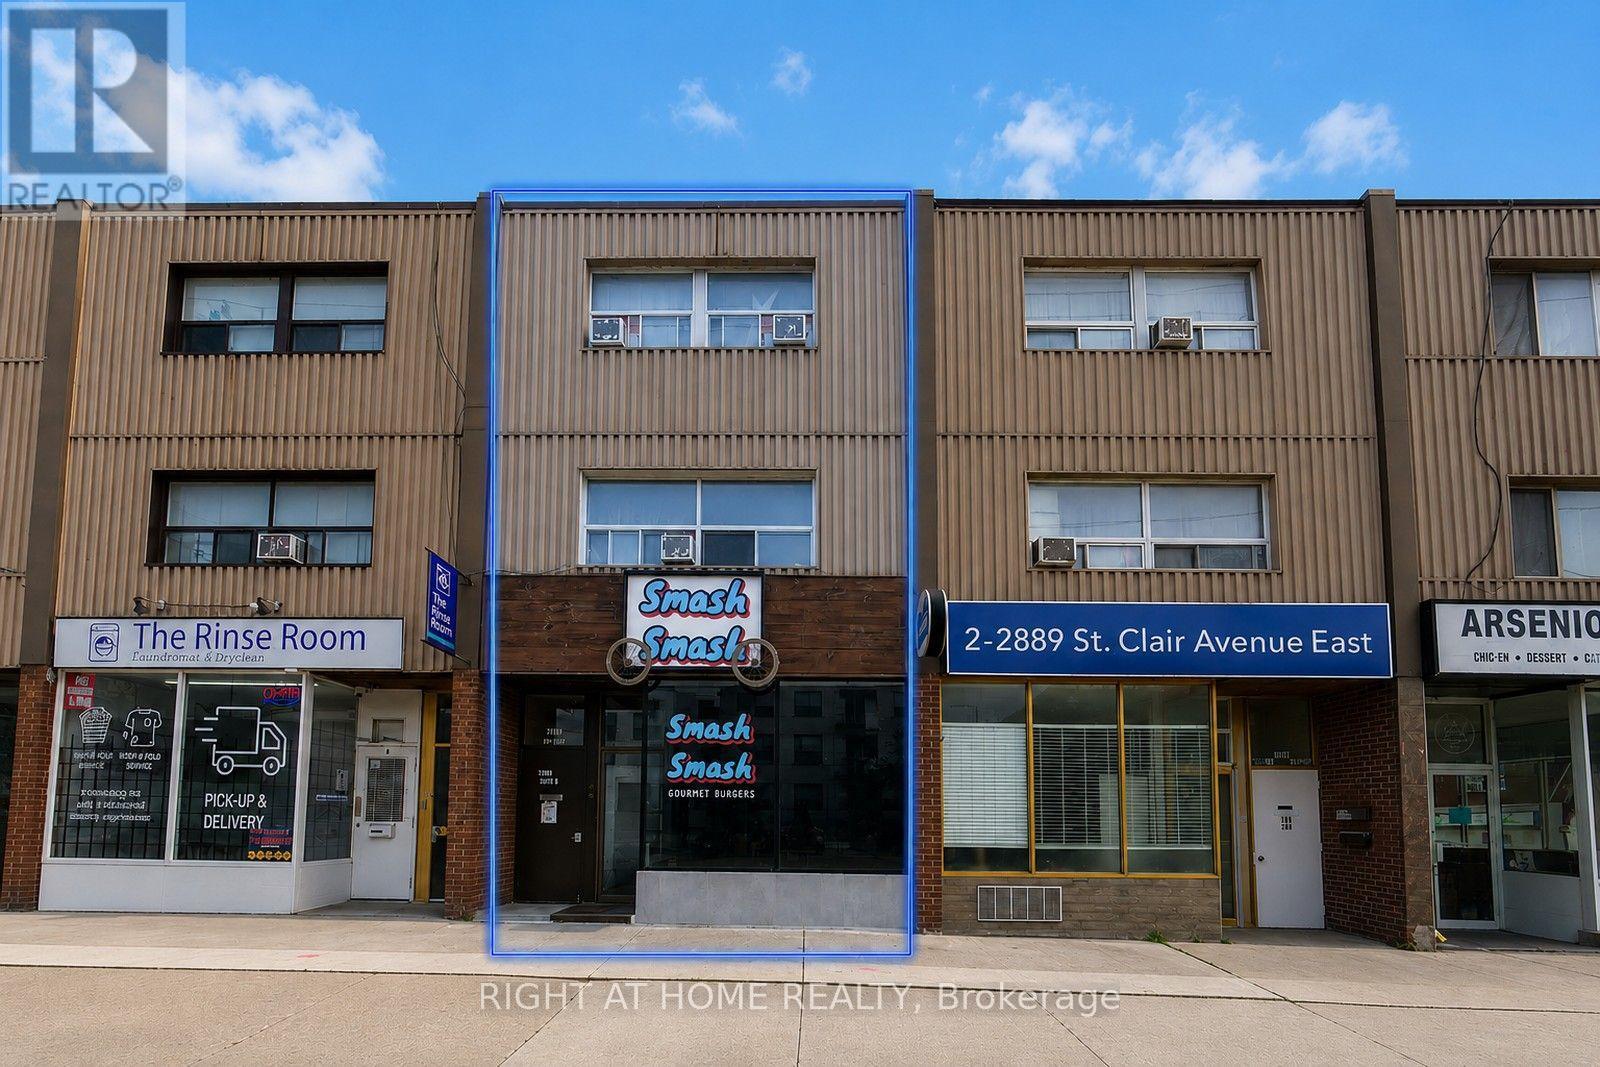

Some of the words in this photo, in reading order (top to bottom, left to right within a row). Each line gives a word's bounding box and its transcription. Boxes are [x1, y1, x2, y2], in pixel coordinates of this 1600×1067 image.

[431, 591, 447, 609] The
[639, 578, 750, 619] Smash
[133, 621, 186, 650] The
[195, 622, 272, 650] Rinse
[282, 623, 366, 651] Room
[430, 617, 453, 638] Room
[638, 625, 750, 666] Smash
[964, 627, 1064, 652] 2-2889
[1073, 627, 1110, 652] St.
[1118, 627, 1185, 653] Clair
[1193, 629, 1303, 653] Avenue
[1311, 629, 1373, 653] East
[215, 651, 265, 665] Dryclean
[1527, 652, 1567, 663] DESSERT
[665, 713, 755, 745] Smash
[666, 752, 757, 784] Smash
[204, 793, 256, 808] PICK-UP
[257, 793, 268, 808] &
[668, 789, 710, 798] GOURMET
[714, 789, 755, 799] BURGERS
[203, 814, 265, 830] DELIVERY
